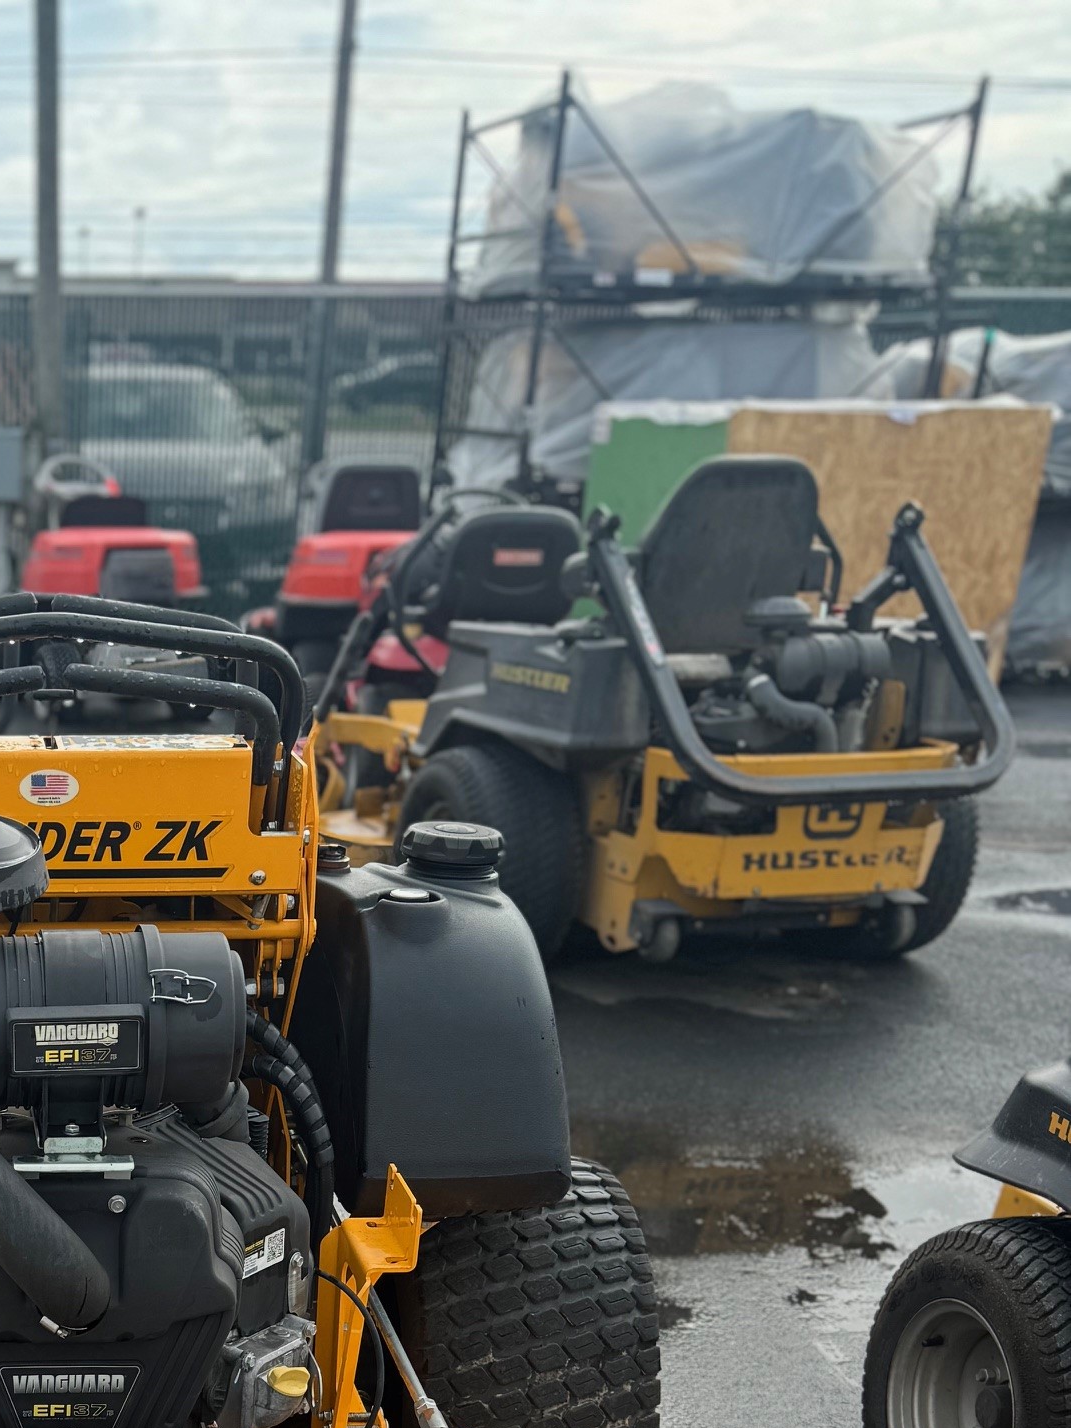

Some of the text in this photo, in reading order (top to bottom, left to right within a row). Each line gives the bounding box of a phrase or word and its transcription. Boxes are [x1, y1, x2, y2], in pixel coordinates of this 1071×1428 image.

[144, 821, 222, 861] ZK
[743, 847, 910, 872] HUSTLER
[35, 1022, 119, 1042] VANGUARD
[1048, 1111, 1071, 1144] H
[12, 1374, 125, 1394] VANGUARD
